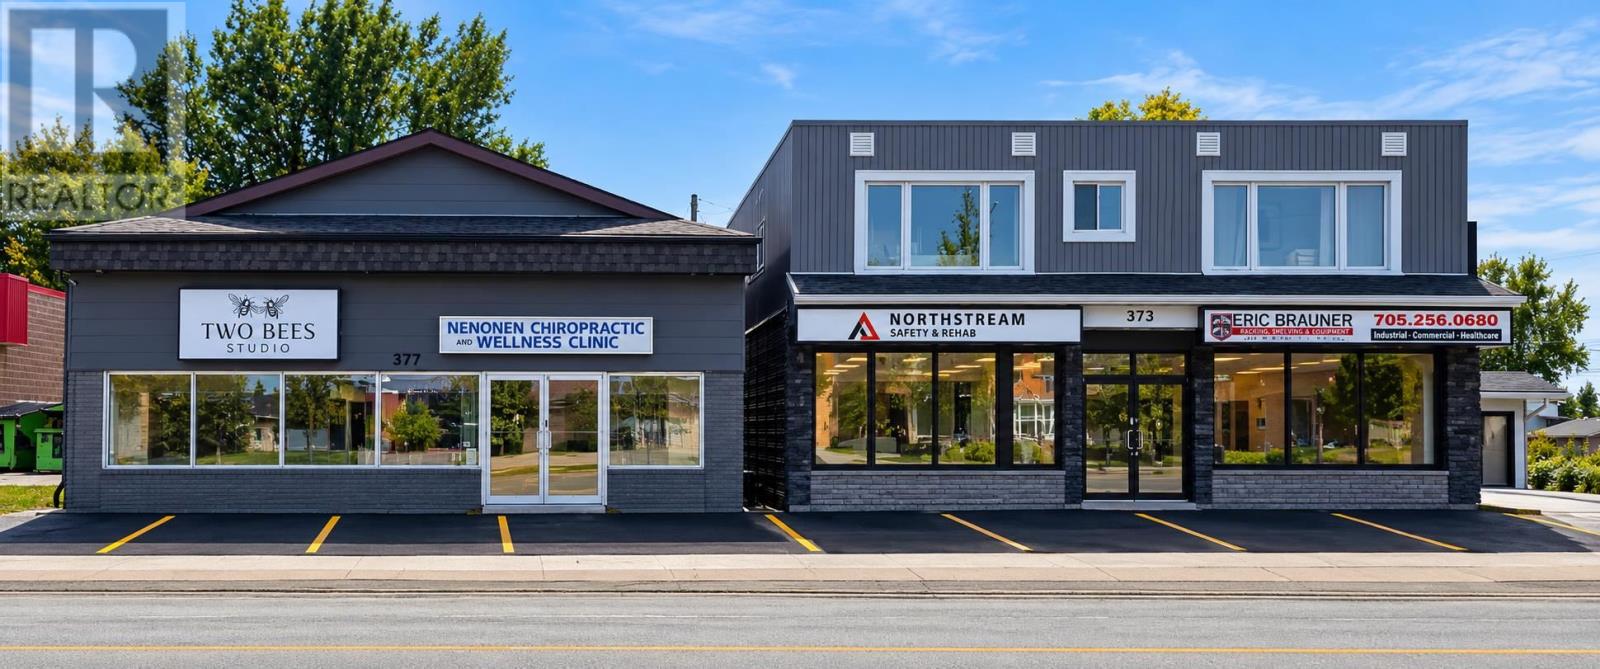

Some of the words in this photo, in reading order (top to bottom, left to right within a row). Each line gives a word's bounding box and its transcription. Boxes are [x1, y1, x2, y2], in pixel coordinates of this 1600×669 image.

[889, 312, 1026, 326] NORTHSTREAM
[1126, 309, 1154, 322] 373
[1233, 313, 1270, 326] ERIC
[1275, 313, 1353, 326] BRAUNER
[1374, 314, 1498, 326] 705.256.0680
[201, 322, 253, 340] TWO
[263, 322, 316, 340] BEES
[447, 322, 524, 334] NENONEN
[530, 321, 646, 336] CHIROPRACTIC
[890, 328, 928, 338] SAFETY
[931, 328, 939, 338] &
[941, 328, 976, 338] REHAB
[1373, 330, 1408, 340] Industrial
[1412, 330, 1455, 340] Commercial
[1460, 330, 1499, 340] Healthcare
[226, 343, 290, 353] STUDIO
[456, 338, 473, 346] AND
[477, 335, 562, 349] WELLNESS
[568, 336, 619, 349] CLINIC
[392, 353, 421, 366] 377
